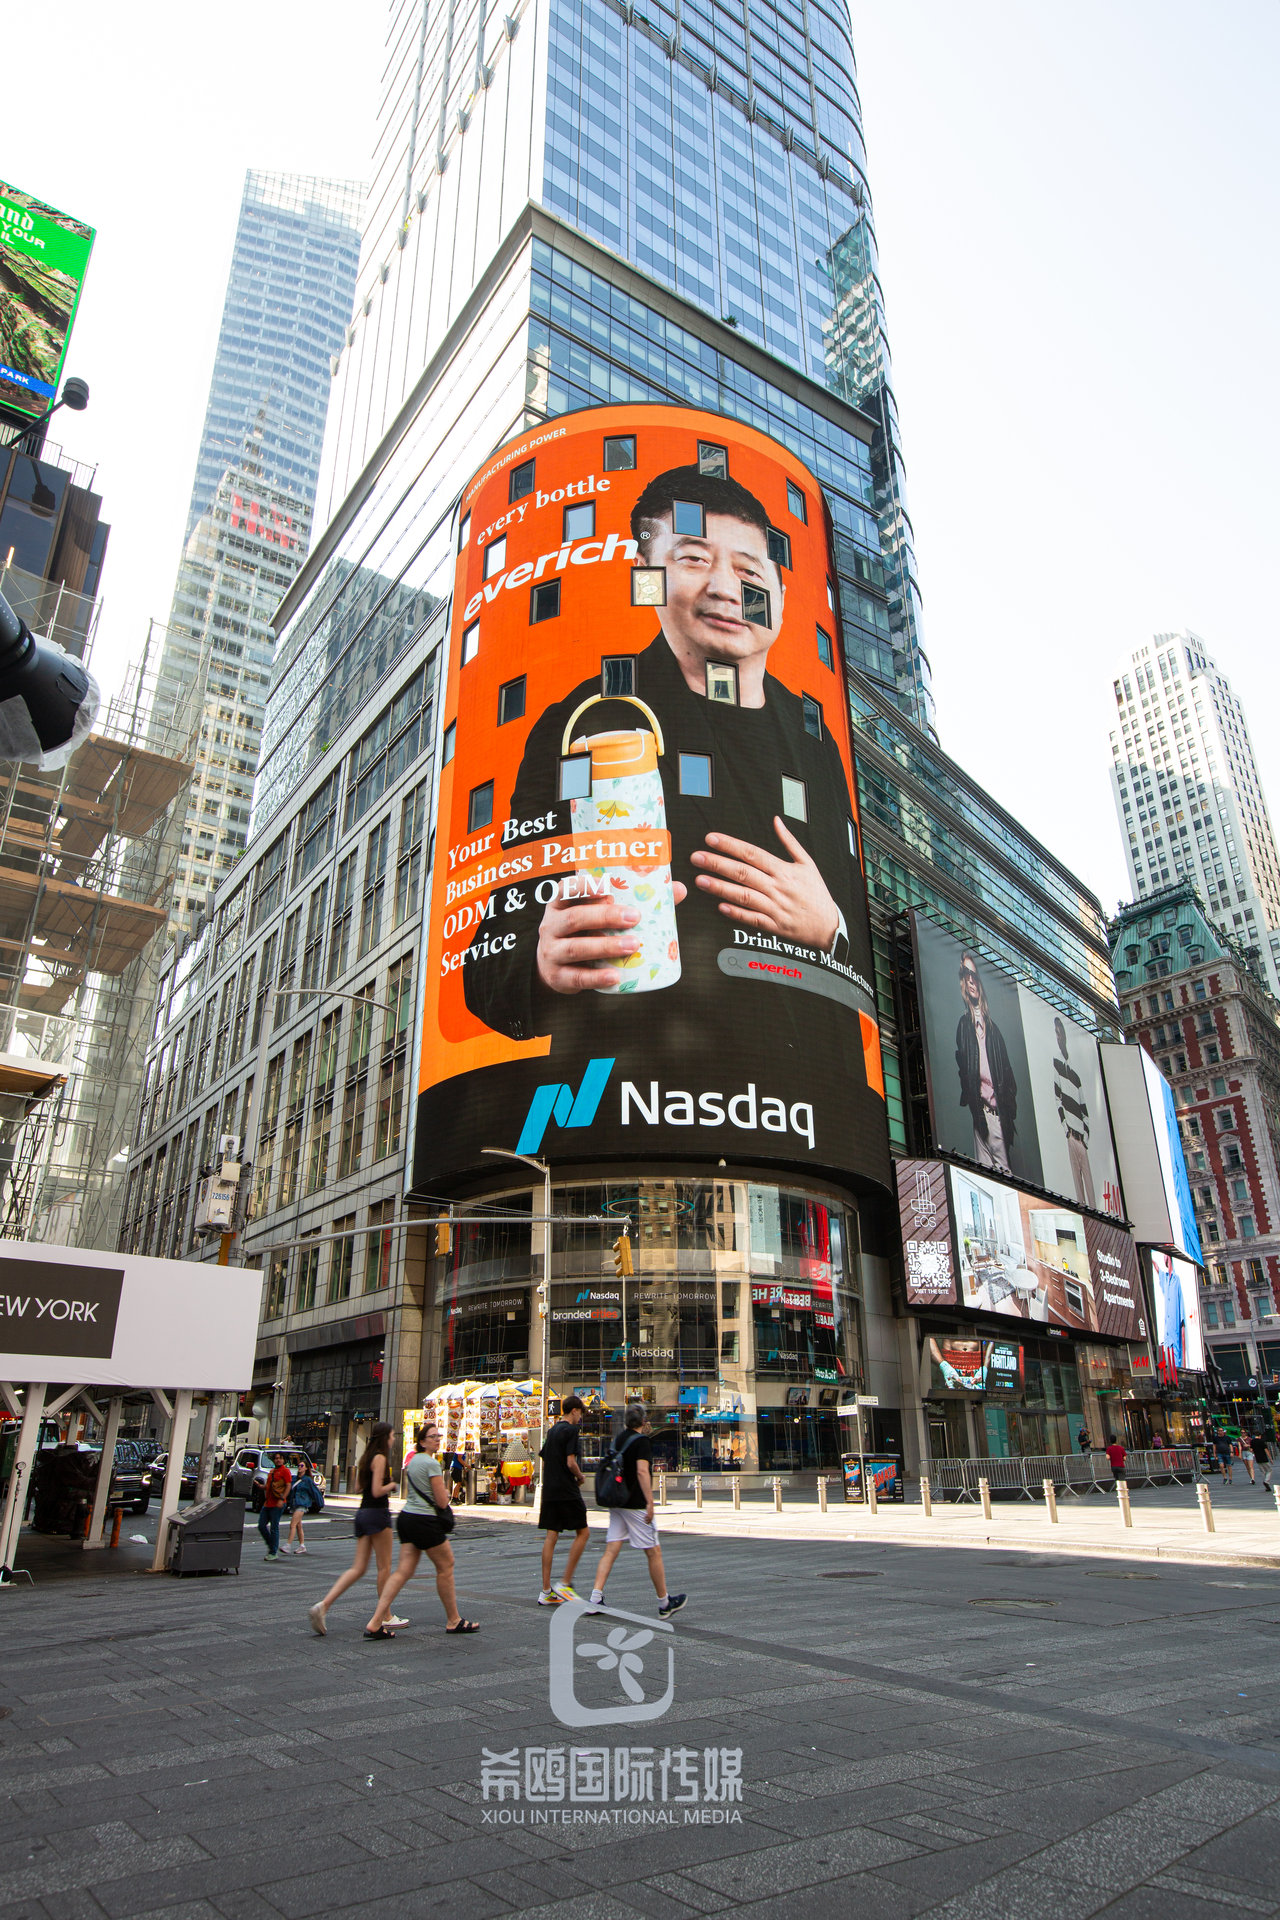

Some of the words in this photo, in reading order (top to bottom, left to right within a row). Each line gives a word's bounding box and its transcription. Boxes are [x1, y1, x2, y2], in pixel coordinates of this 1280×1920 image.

[1, 220, 45, 249] YOUR
[0, 367, 29, 385] PARK
[465, 444, 527, 504] MANUFACTURING
[529, 428, 567, 449] POWER
[477, 502, 529, 546] every
[535, 474, 611, 510] bottle
[463, 533, 639, 622] everich
[447, 832, 495, 871] Your
[501, 810, 558, 844] Best
[445, 853, 533, 907] Business
[541, 838, 662, 868] Partner
[443, 897, 497, 940] ODM
[503, 887, 527, 913] &
[535, 872, 613, 905] OEM
[440, 932, 517, 977] Service
[733, 929, 817, 962] Drinkware
[748, 960, 803, 980] everich
[621, 1081, 816, 1150] Nasdaq
[914, 1215, 937, 1228] EOS
[1096, 1249, 1115, 1267] Studio
[1114, 1256, 1122, 1269] to
[1099, 1269, 1131, 1289] 3-Bedroom
[35, 1297, 100, 1322] YORK
[590, 1291, 619, 1300] Nasdaq
[634, 1292, 668, 1300] REWRITE
[672, 1292, 717, 1300] TOMORROW
[1103, 1289, 1135, 1309] Apartments
[632, 1347, 674, 1360] Nasdaq
